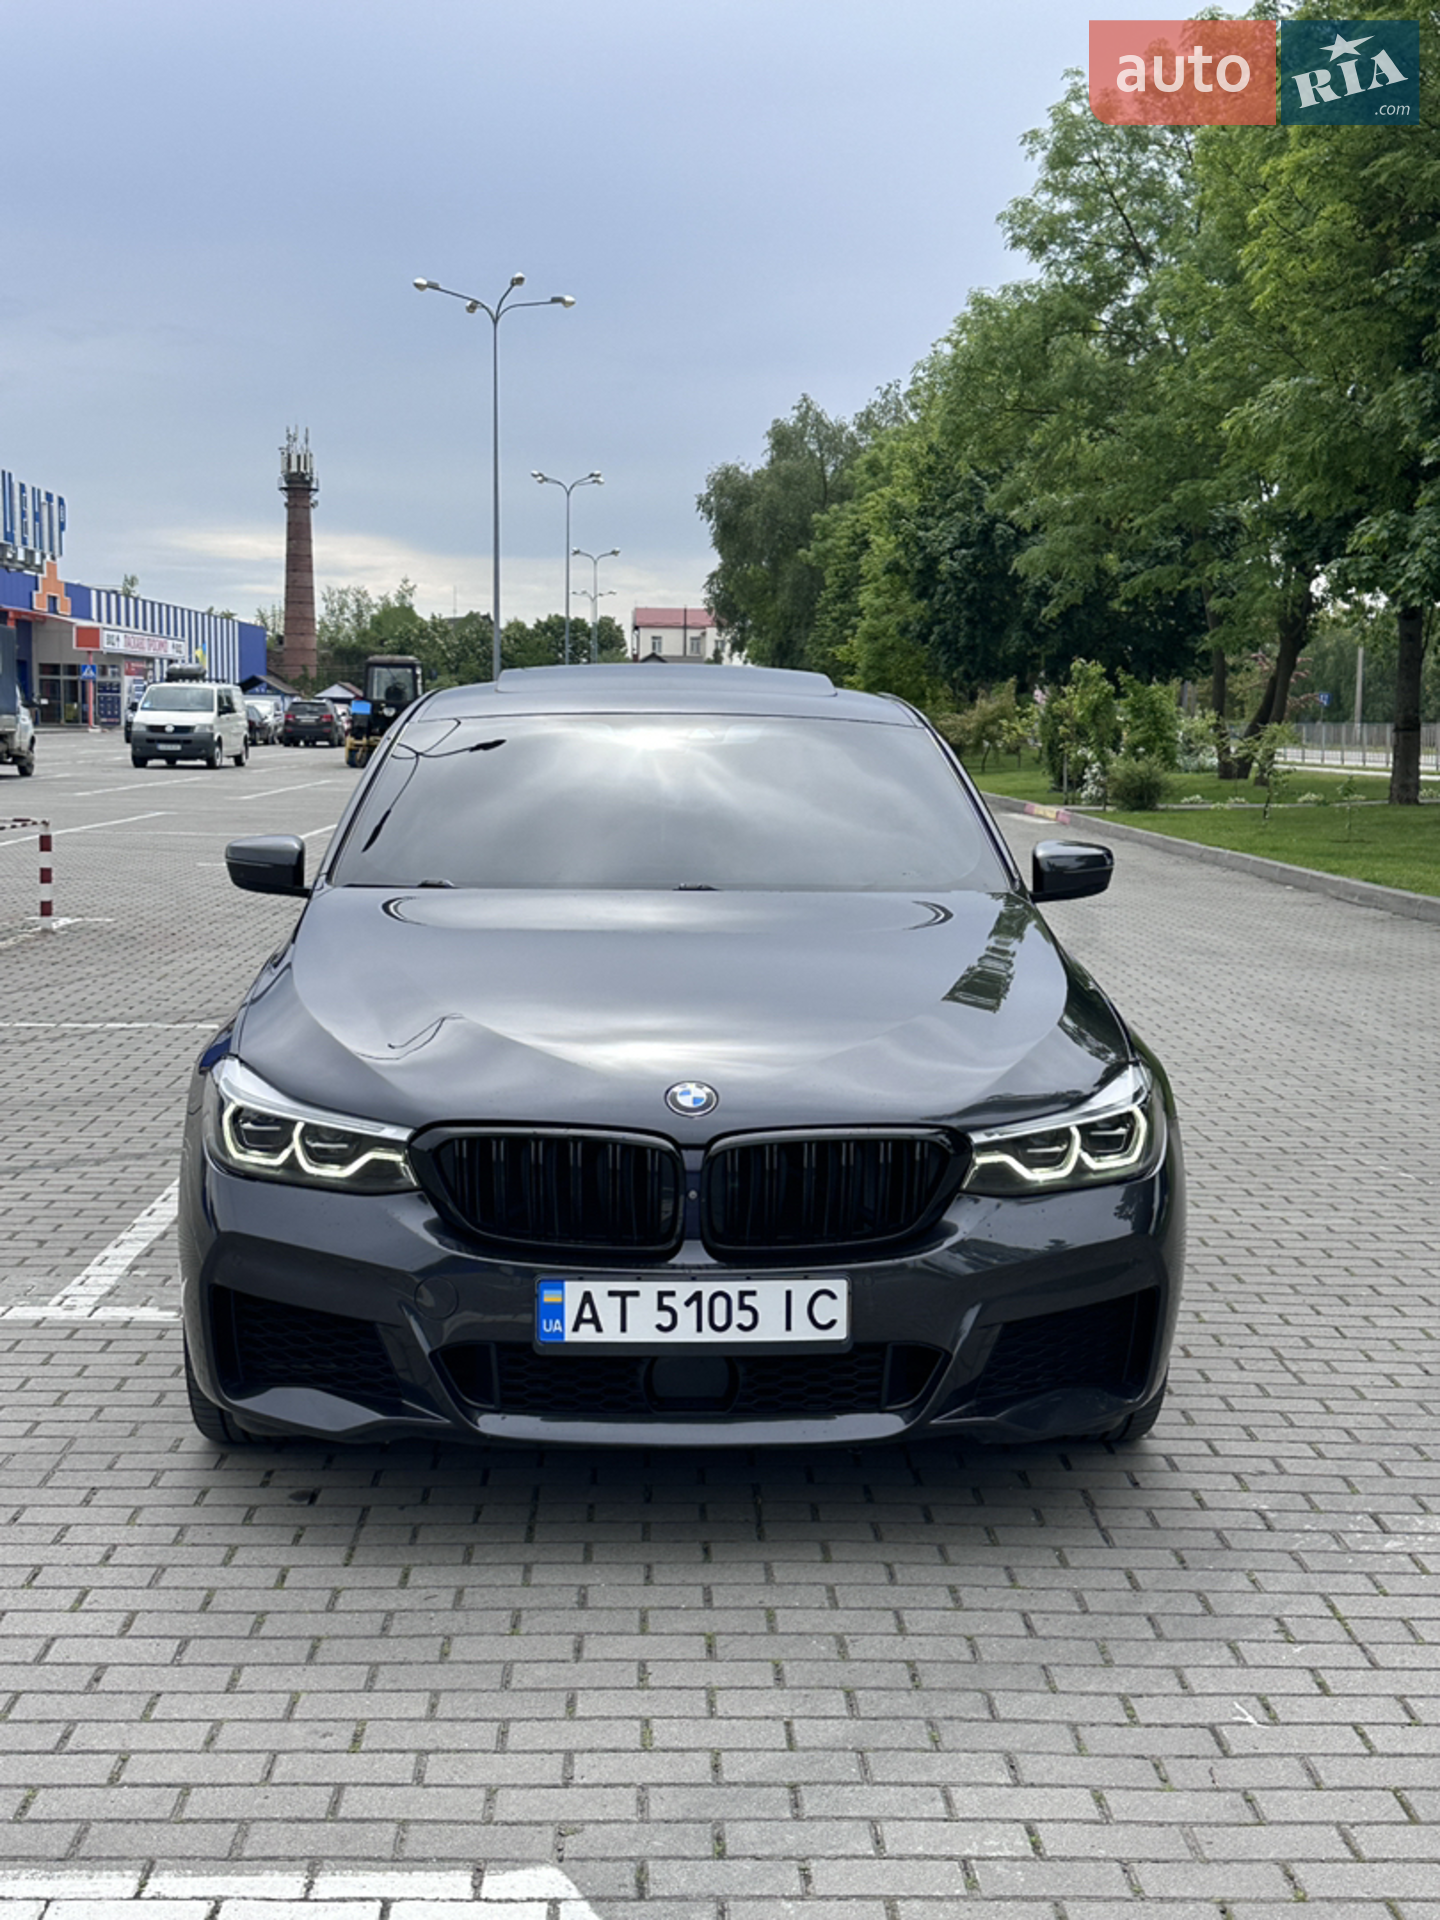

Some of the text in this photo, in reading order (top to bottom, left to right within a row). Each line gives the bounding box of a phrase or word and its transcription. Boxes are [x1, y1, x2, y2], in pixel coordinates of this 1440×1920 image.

[571, 1288, 838, 1333] AT 5105 IC
[543, 1319, 563, 1333] UA
